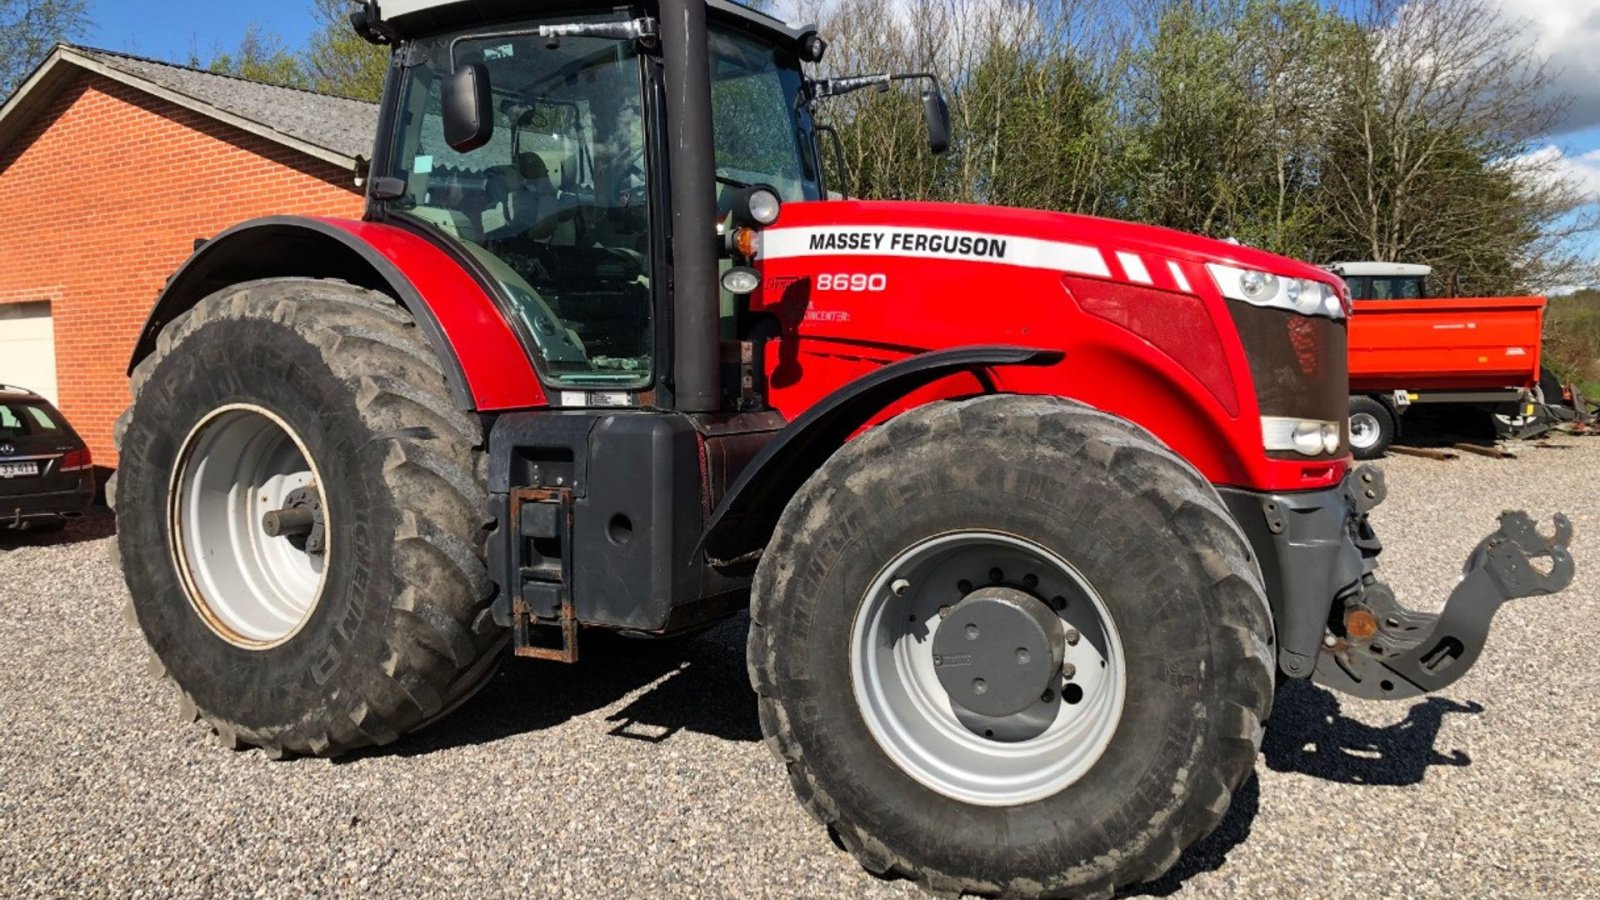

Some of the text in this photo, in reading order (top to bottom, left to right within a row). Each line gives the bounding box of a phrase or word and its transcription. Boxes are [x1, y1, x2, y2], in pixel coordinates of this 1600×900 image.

[809, 233, 1007, 258] MASSEY FERGUSON
[817, 274, 887, 291] 8690
